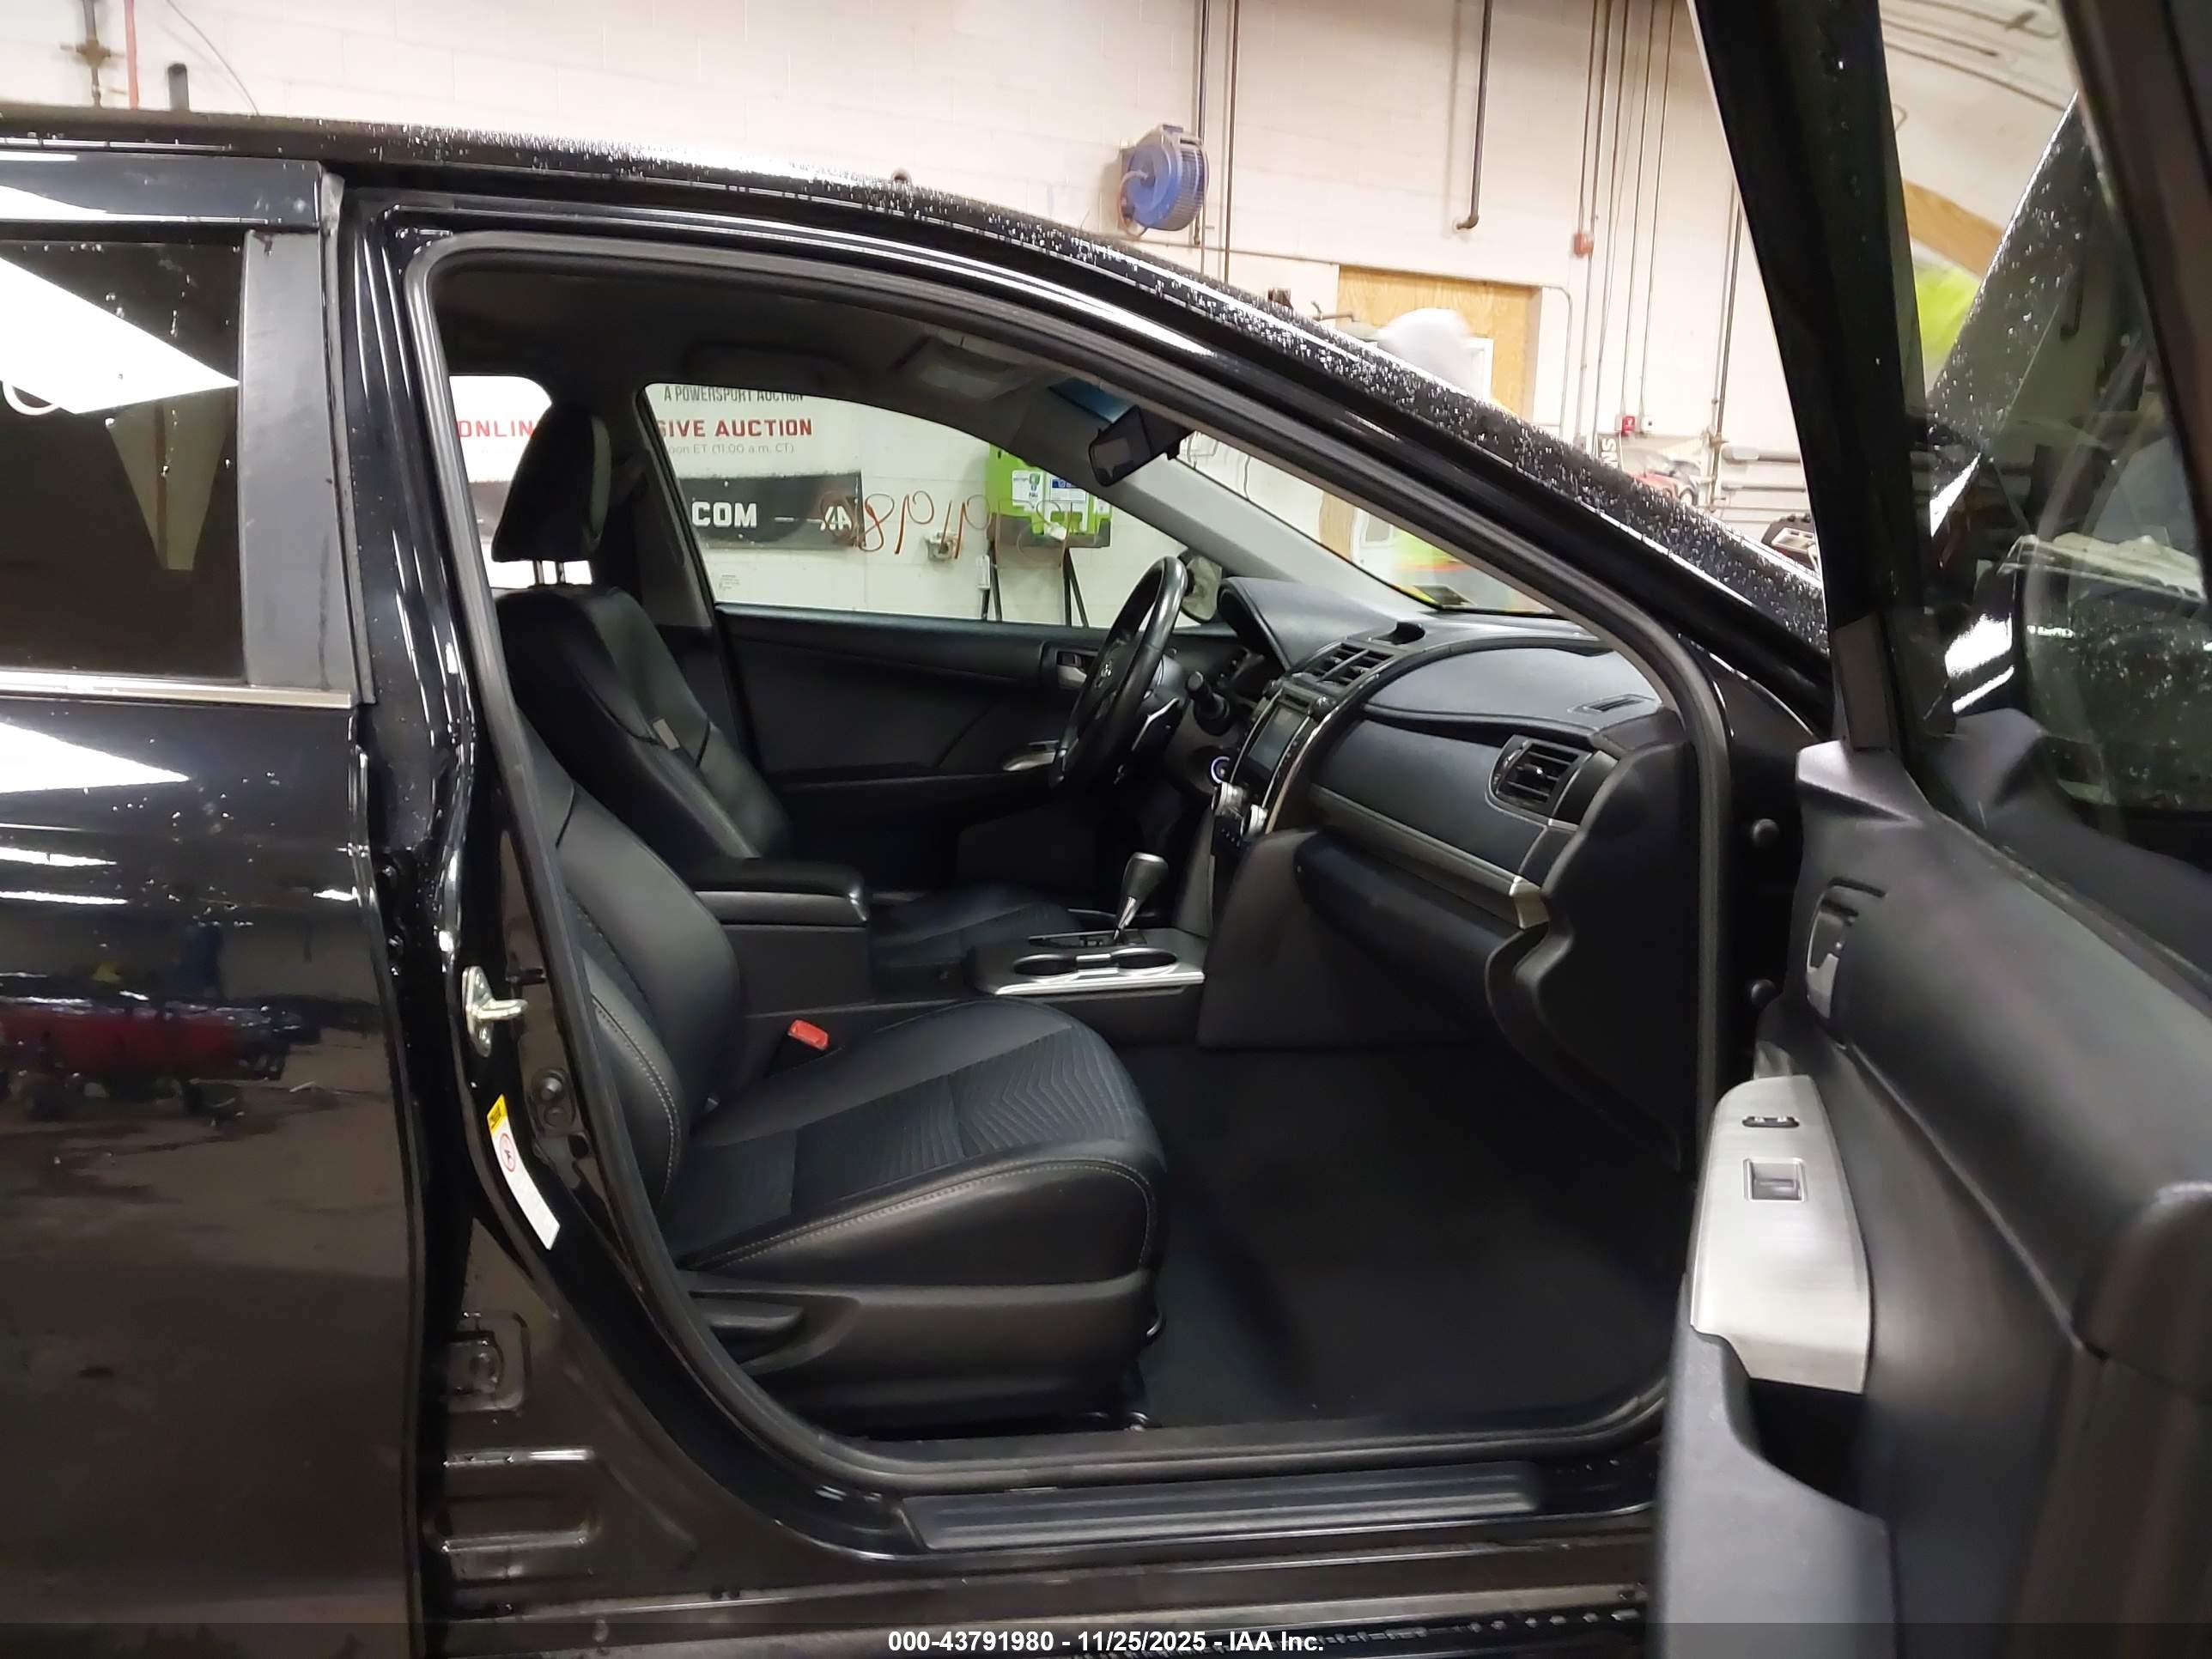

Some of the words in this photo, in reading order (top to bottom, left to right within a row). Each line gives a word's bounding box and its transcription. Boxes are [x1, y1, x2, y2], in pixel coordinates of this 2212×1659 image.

[665, 386, 672, 401] A
[675, 386, 751, 402] POWERSPORT
[715, 418, 812, 436] AUCTION
[692, 501, 757, 527] COM
